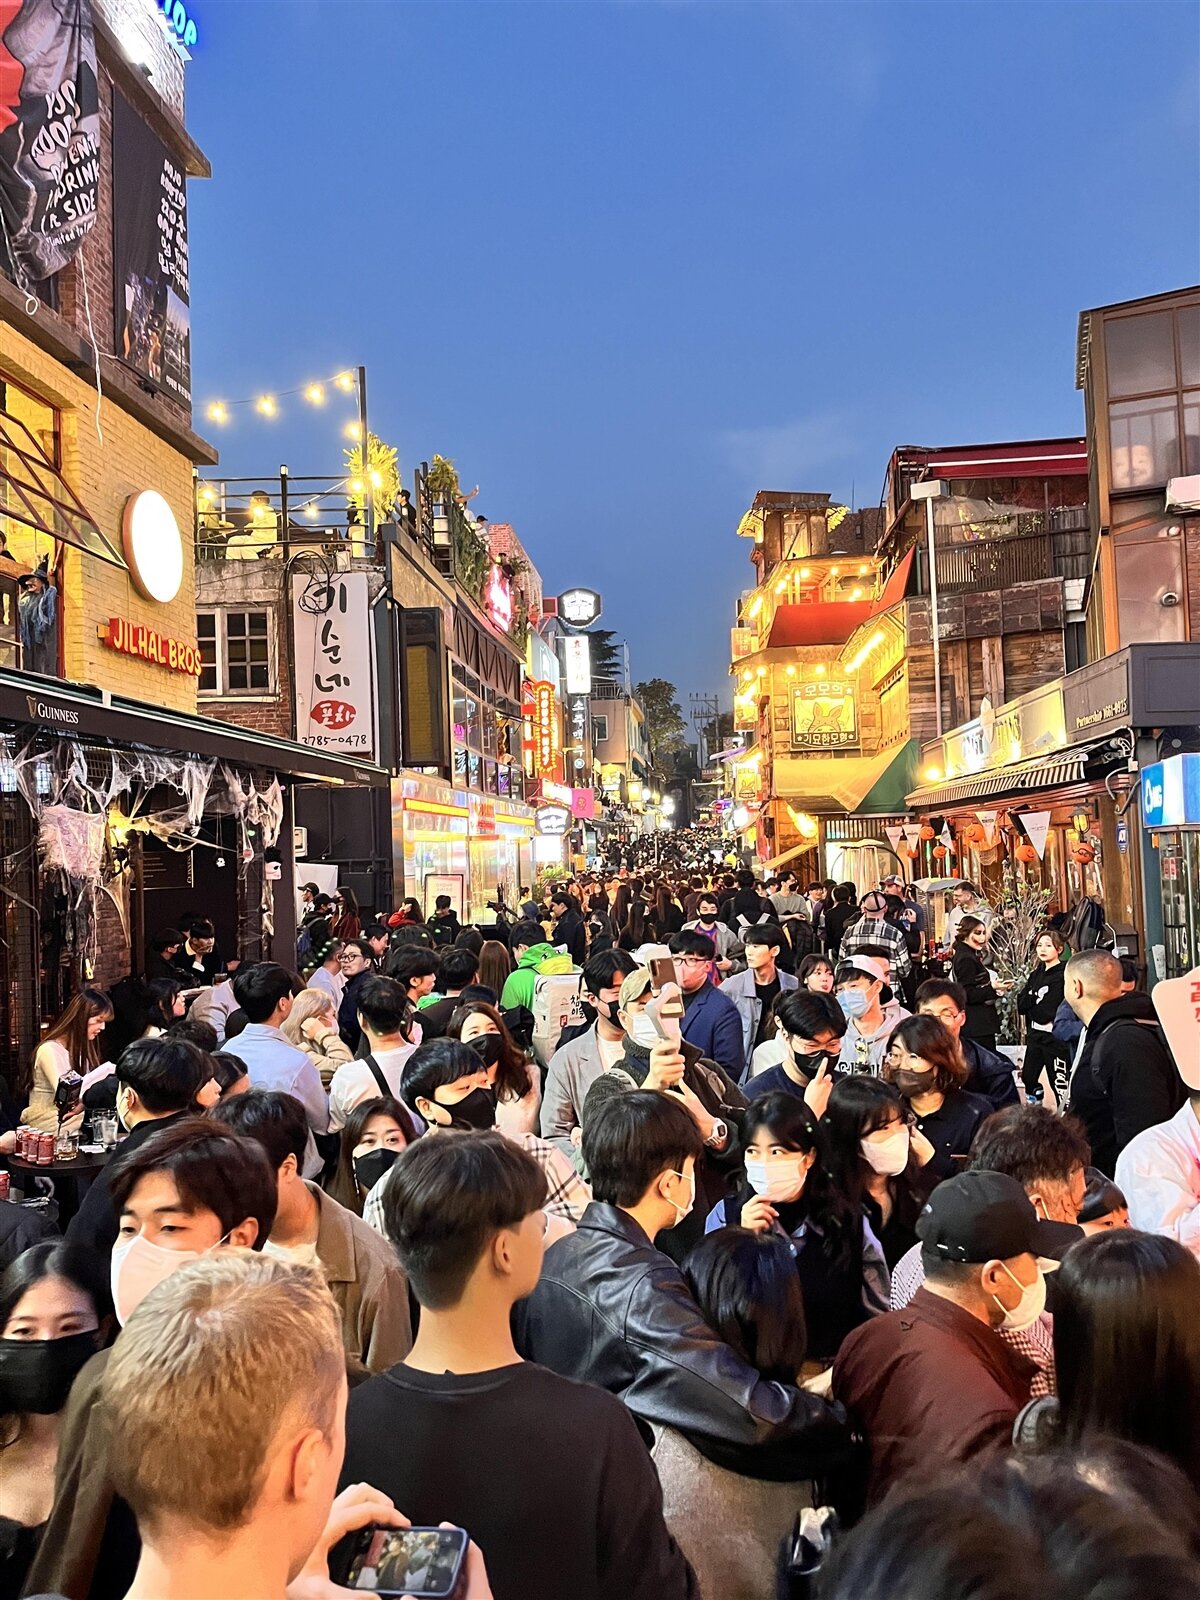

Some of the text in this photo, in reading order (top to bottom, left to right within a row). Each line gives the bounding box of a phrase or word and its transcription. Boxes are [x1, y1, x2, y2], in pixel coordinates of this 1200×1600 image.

[63, 188, 96, 221] SIDE
[113, 617, 202, 676] JILHAL BROS
[804, 683, 843, 697] 모모의
[320, 702, 356, 725] 포차
